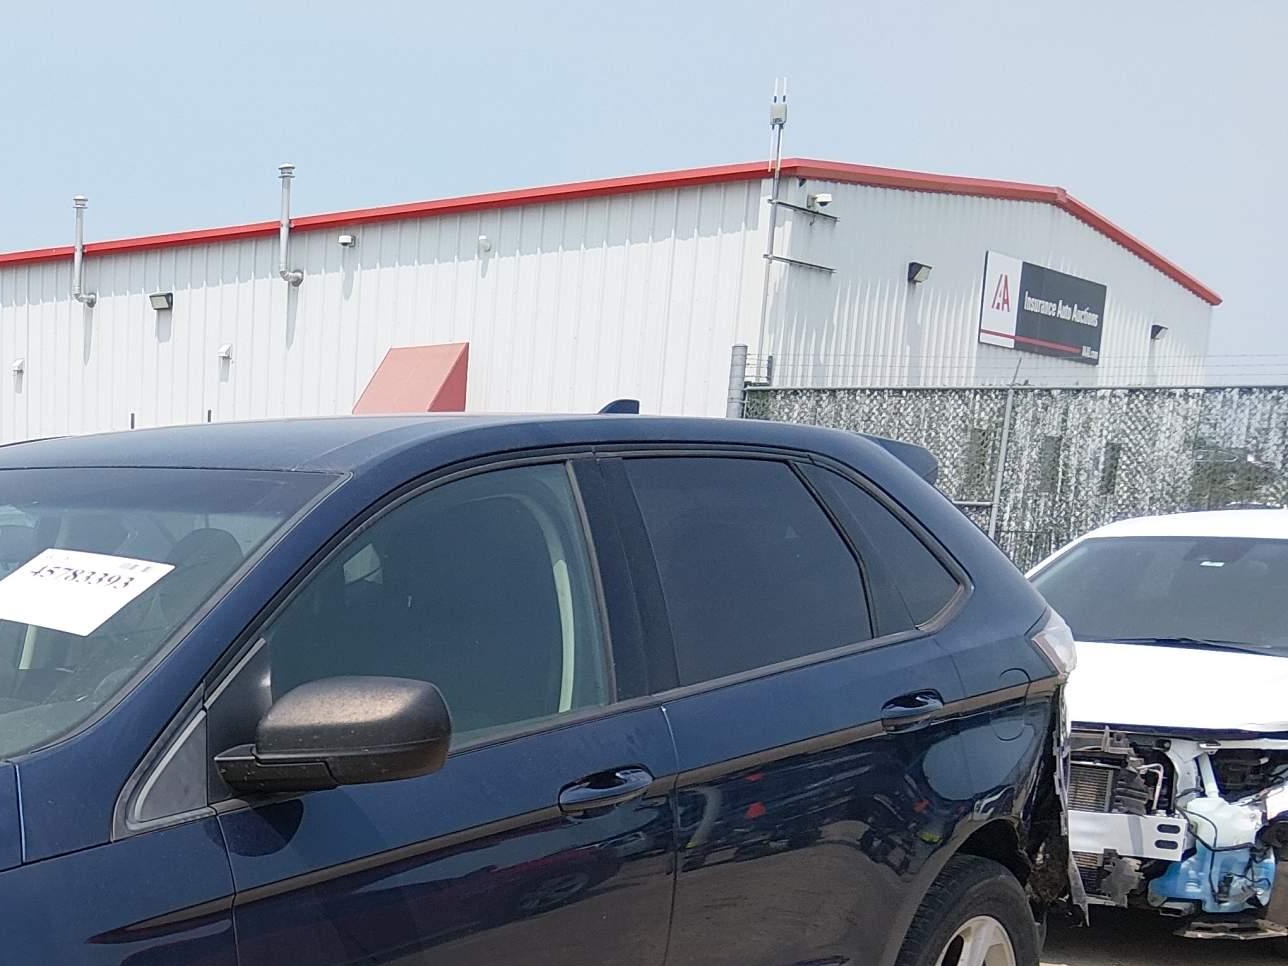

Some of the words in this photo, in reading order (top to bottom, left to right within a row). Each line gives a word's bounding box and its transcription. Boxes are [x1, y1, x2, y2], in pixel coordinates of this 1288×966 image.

[1024, 290, 1057, 317] Insurance
[1056, 299, 1072, 321] Auto
[1072, 303, 1099, 327] Auctions
